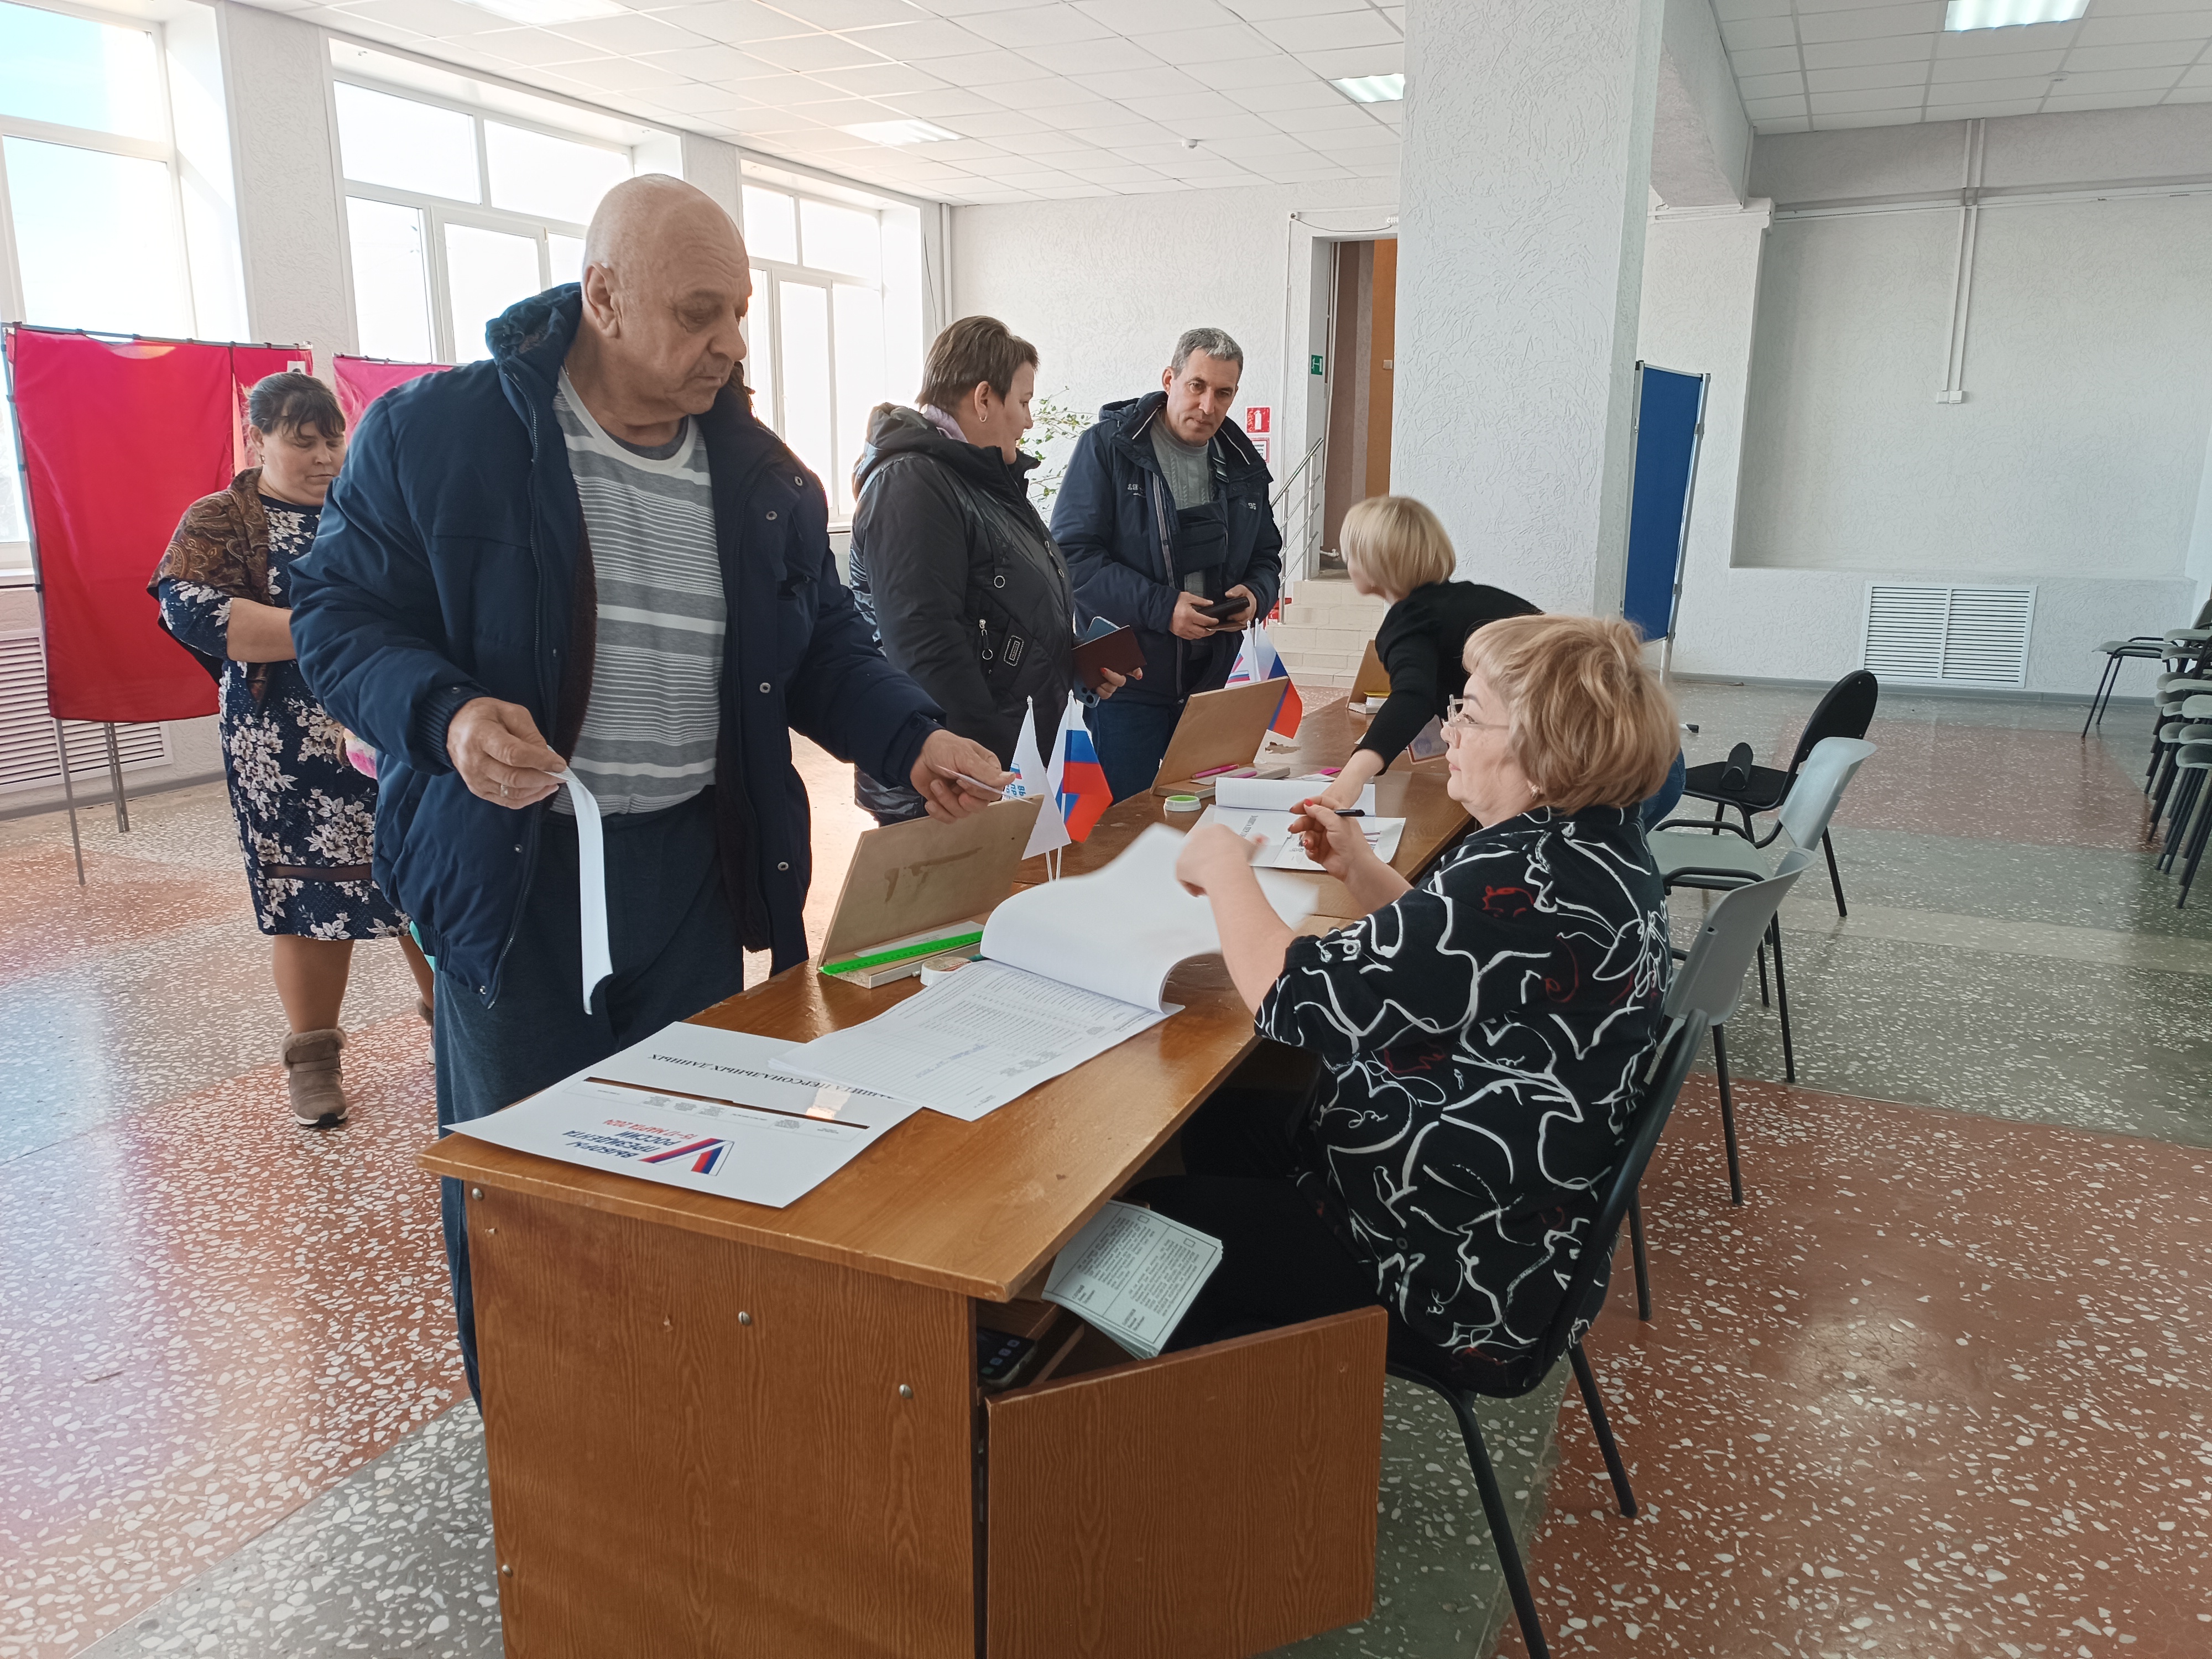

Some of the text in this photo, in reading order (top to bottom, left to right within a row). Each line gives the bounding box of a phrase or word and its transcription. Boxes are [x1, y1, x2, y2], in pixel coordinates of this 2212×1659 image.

[648, 1053, 713, 1070] ДАННЫХ
[712, 1065, 831, 1090] ПЕРСОНАЛЬНЫХ
[603, 1119, 633, 1128] 2024
[627, 1123, 669, 1135] МАРТА
[561, 1130, 661, 1153] ПРЕЗИДЕНТА
[614, 1130, 681, 1146] РОССИИ
[565, 1141, 639, 1159] ВЫБОРЫ
